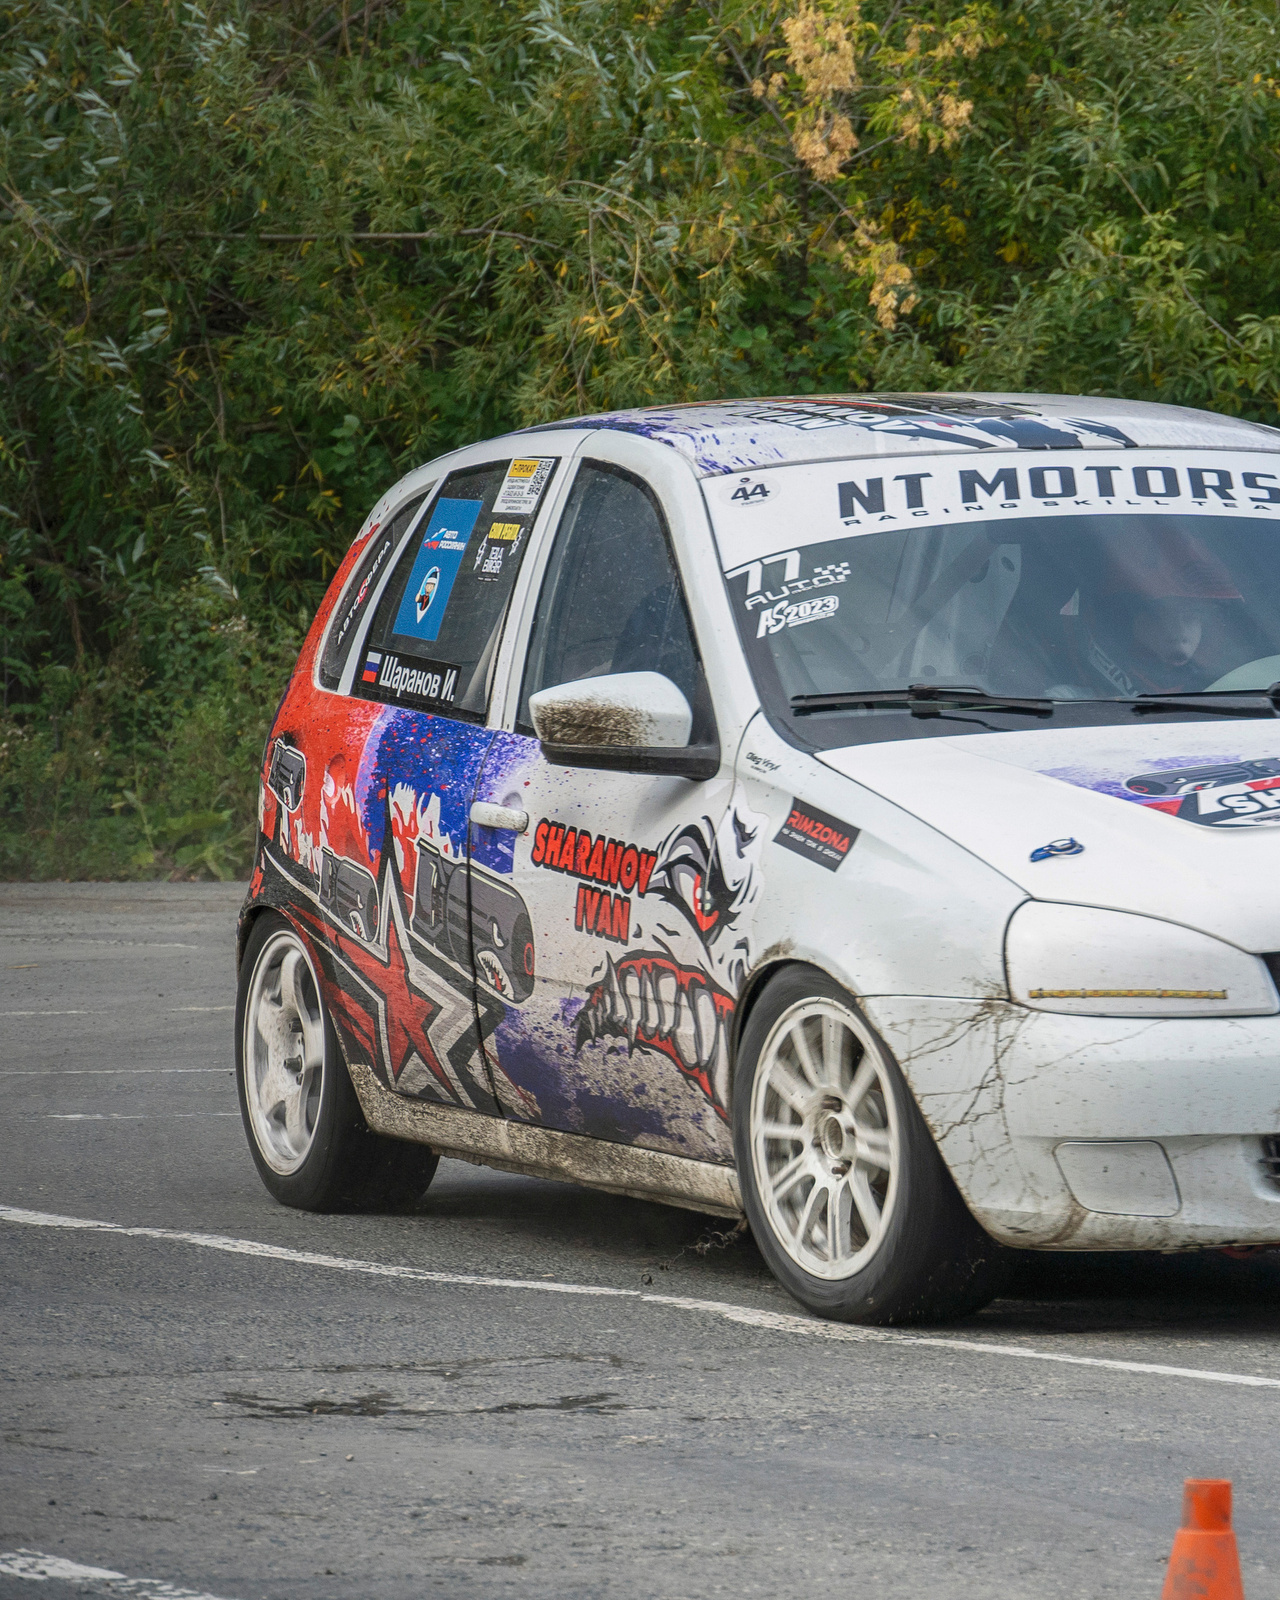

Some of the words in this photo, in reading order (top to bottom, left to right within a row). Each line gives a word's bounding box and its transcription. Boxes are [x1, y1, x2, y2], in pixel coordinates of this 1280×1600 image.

[731, 483, 771, 501] 44
[837, 472, 933, 519] NT
[843, 502, 1019, 526] RACING
[1042, 499, 1170, 507] SKILL
[723, 549, 801, 596] 77
[744, 575, 837, 611] AUTO
[378, 655, 441, 698] Шаранов
[440, 668, 457, 702] И.
[746, 752, 763, 764] Oleg
[786, 810, 850, 853] RIMZONA
[531, 817, 658, 899] SHARANOV
[575, 882, 631, 946] IVAN
